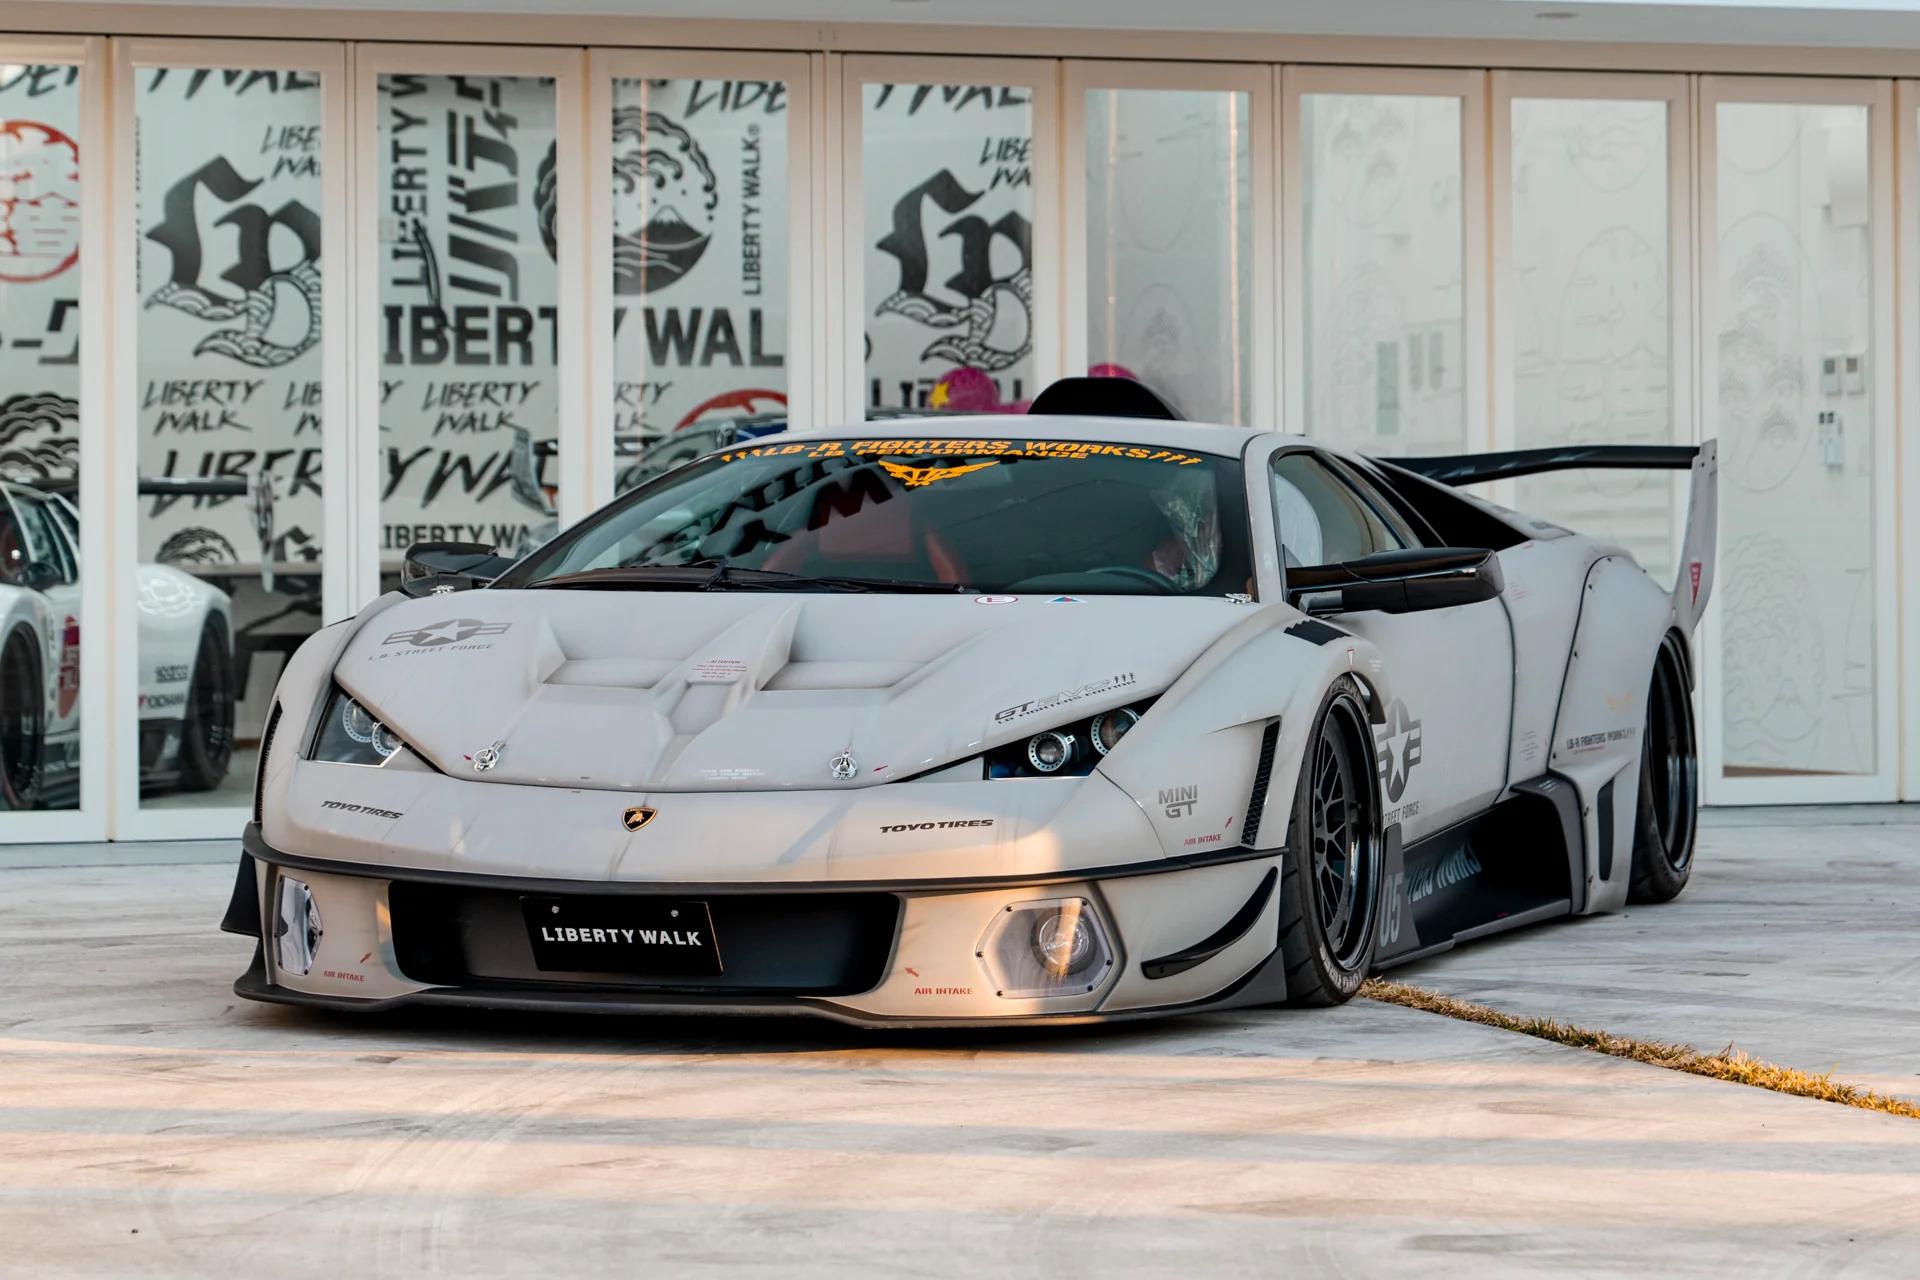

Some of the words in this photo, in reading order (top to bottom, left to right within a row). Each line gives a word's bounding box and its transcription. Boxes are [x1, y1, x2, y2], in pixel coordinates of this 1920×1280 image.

[742, 205, 761, 295] LIBERTY
[142, 379, 264, 410] LIBERTY
[420, 381, 540, 412] LIBERTY
[153, 409, 252, 436] WALK
[432, 411, 528, 437] WALK
[762, 442, 842, 457] LB-R
[850, 440, 1012, 451] FIGHTERS
[808, 449, 846, 458] LB
[855, 448, 1089, 459] PERFORMANCE
[394, 646, 445, 657] STREET
[450, 643, 495, 651] FORCE
[1018, 696, 1082, 718] FIGHTERS
[1085, 680, 1136, 697] EDITION
[1158, 784, 1198, 805] MINI
[320, 801, 361, 812] TOYO
[361, 807, 404, 820] TIRES
[1165, 800, 1198, 819] GT
[1402, 800, 1420, 821] FORCE
[880, 822, 935, 833] TOYO
[937, 819, 994, 829] TIRES
[1198, 833, 1222, 844] INTAKE
[1380, 872, 1403, 948] 05
[541, 927, 635, 943] LIBERTY
[639, 930, 702, 946] WALK
[323, 970, 336, 978] AIR
[337, 972, 365, 982] INTAKE
